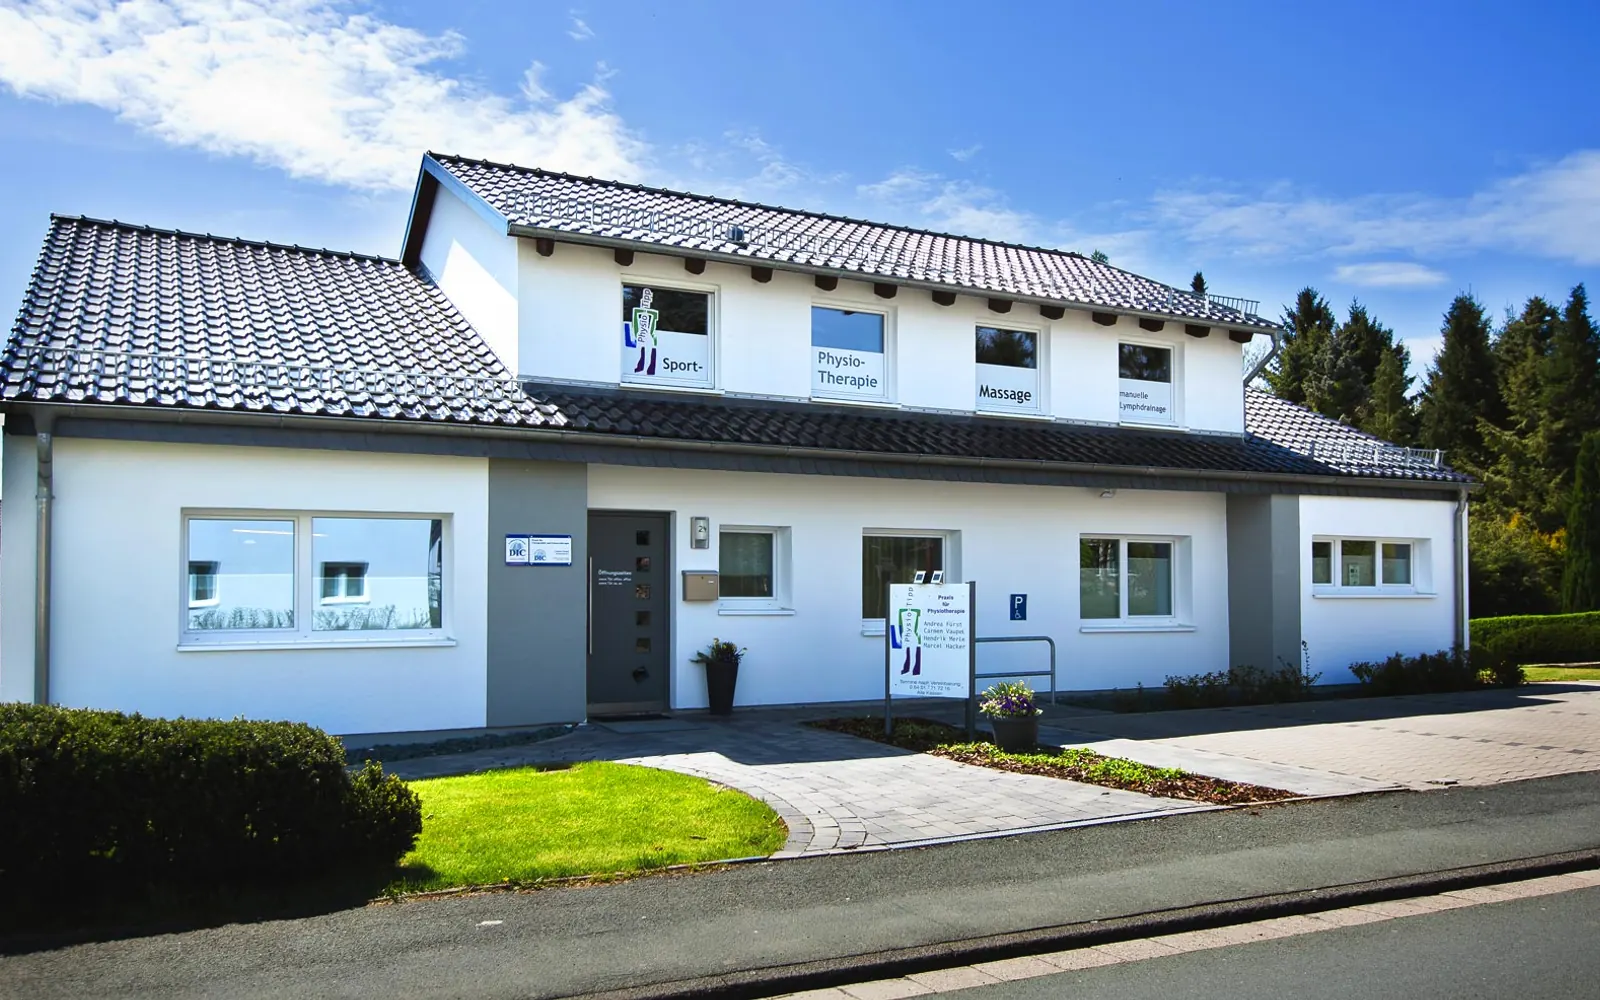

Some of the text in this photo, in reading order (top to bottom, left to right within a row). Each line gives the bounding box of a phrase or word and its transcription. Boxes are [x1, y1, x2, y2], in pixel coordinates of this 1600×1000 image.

[663, 357, 703, 373] Sport-
[818, 351, 865, 369] Physio-
[818, 370, 878, 389] Therapie
[979, 384, 1032, 404] Massage
[1119, 391, 1149, 400] manuelle
[1119, 401, 1167, 414] Lymphdrainage
[1015, 596, 1023, 609] P
